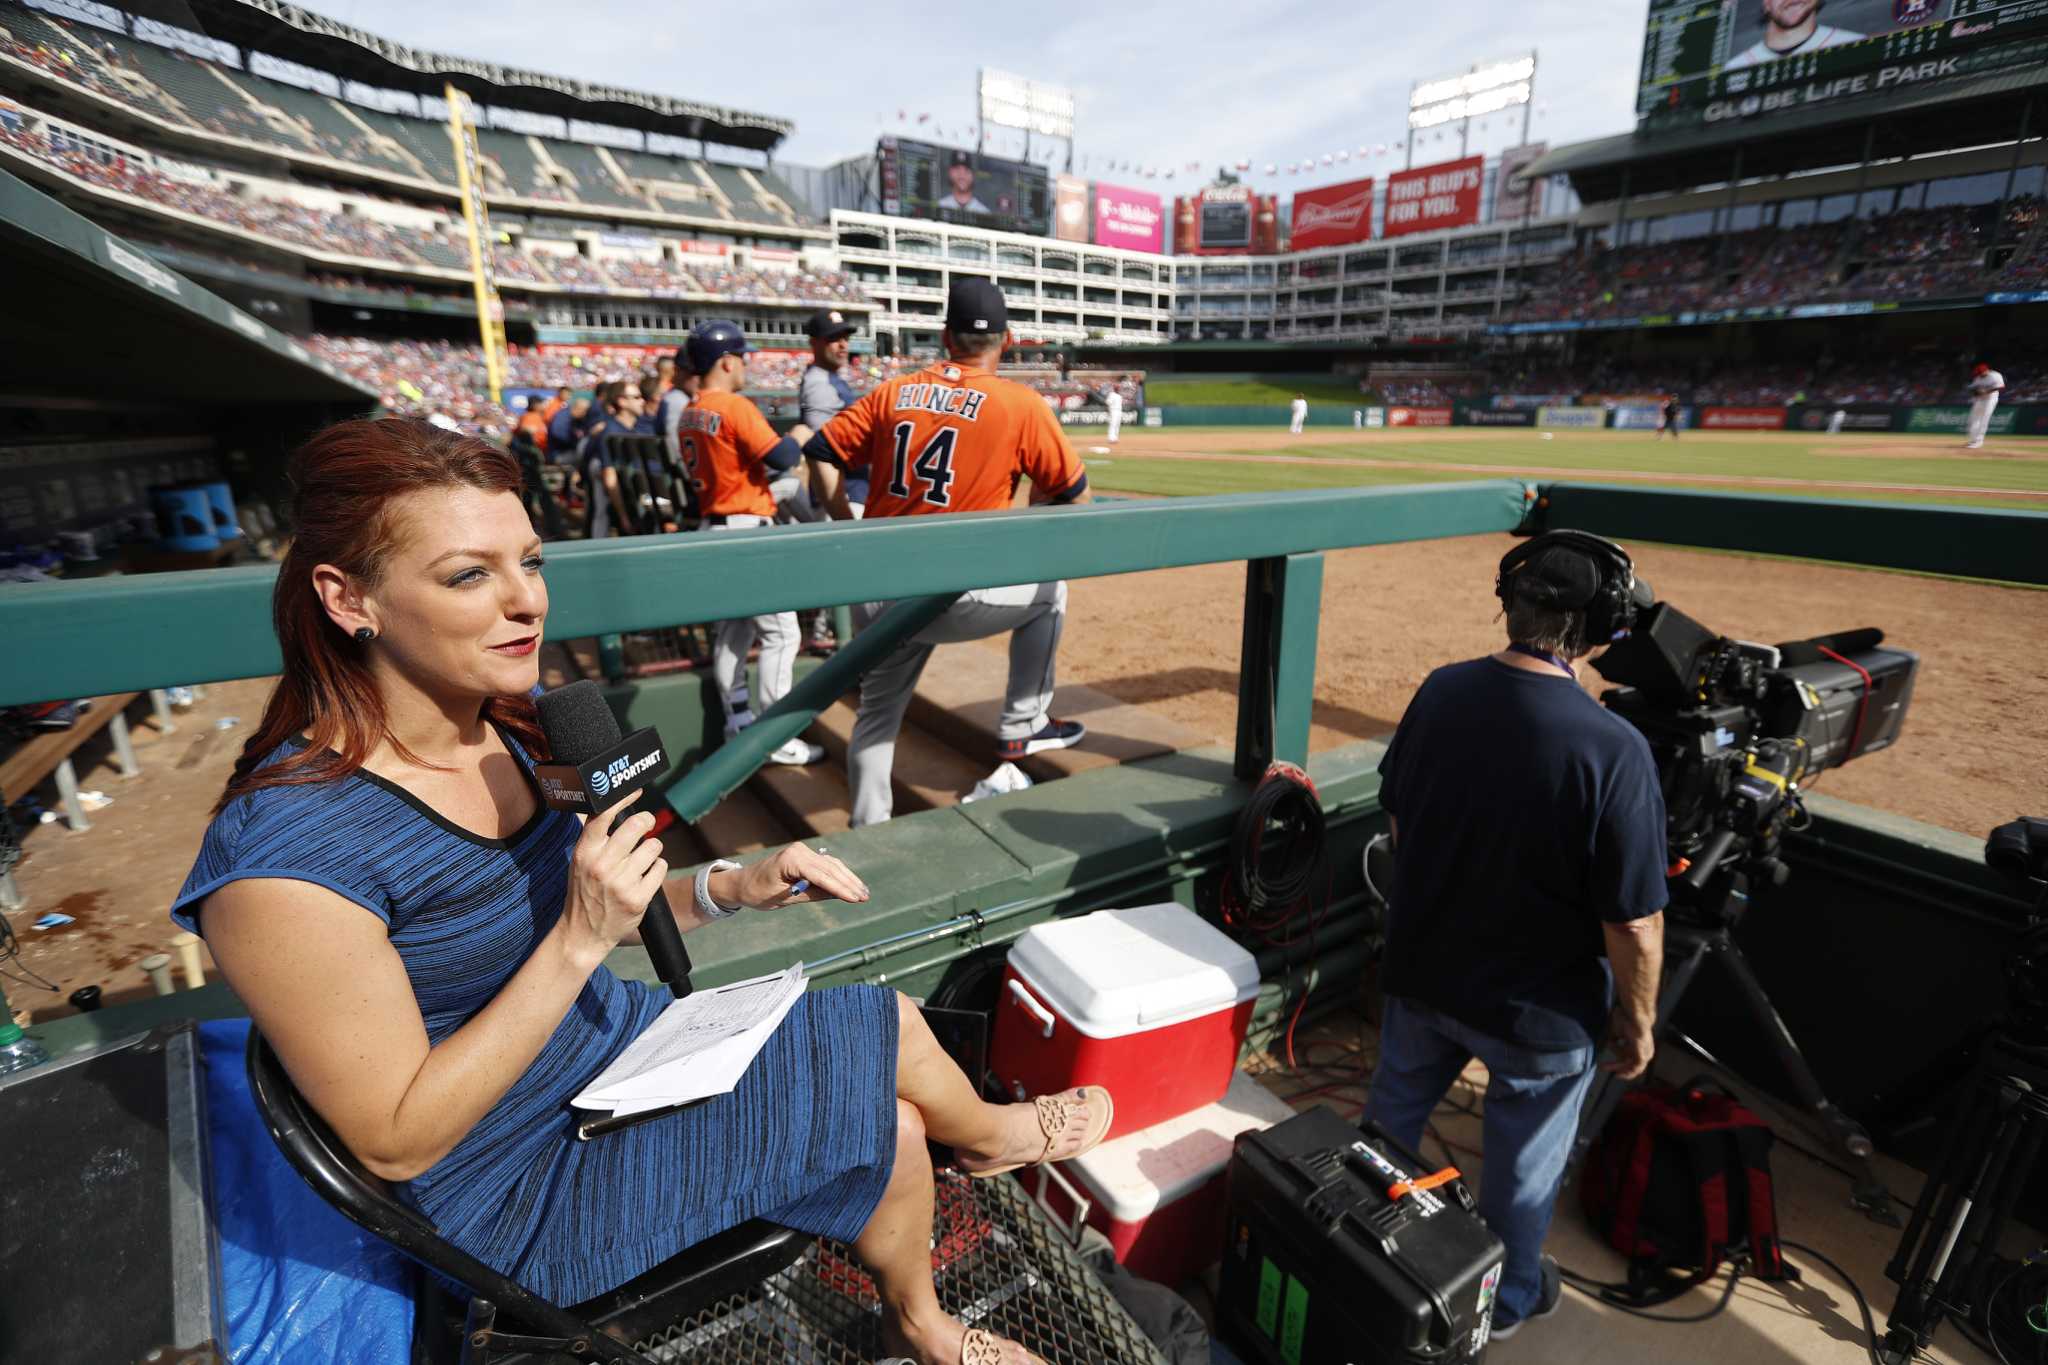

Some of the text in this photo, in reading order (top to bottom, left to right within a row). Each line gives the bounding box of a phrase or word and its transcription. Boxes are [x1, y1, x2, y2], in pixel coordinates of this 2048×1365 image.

[1703, 89, 1797, 122] GLOBE
[1804, 75, 1868, 102] LIFE
[1875, 57, 1960, 88] PARK
[1390, 178, 1426, 201] THIS
[1428, 166, 1480, 195] BUD'S
[1388, 195, 1460, 223] FOR YOU.
[895, 383, 987, 422] HINCH
[888, 421, 959, 507] 14
[608, 754, 630, 776] AT&T
[611, 750, 661, 789] SPORTSNET
[553, 789, 586, 802] SPORTSNET
